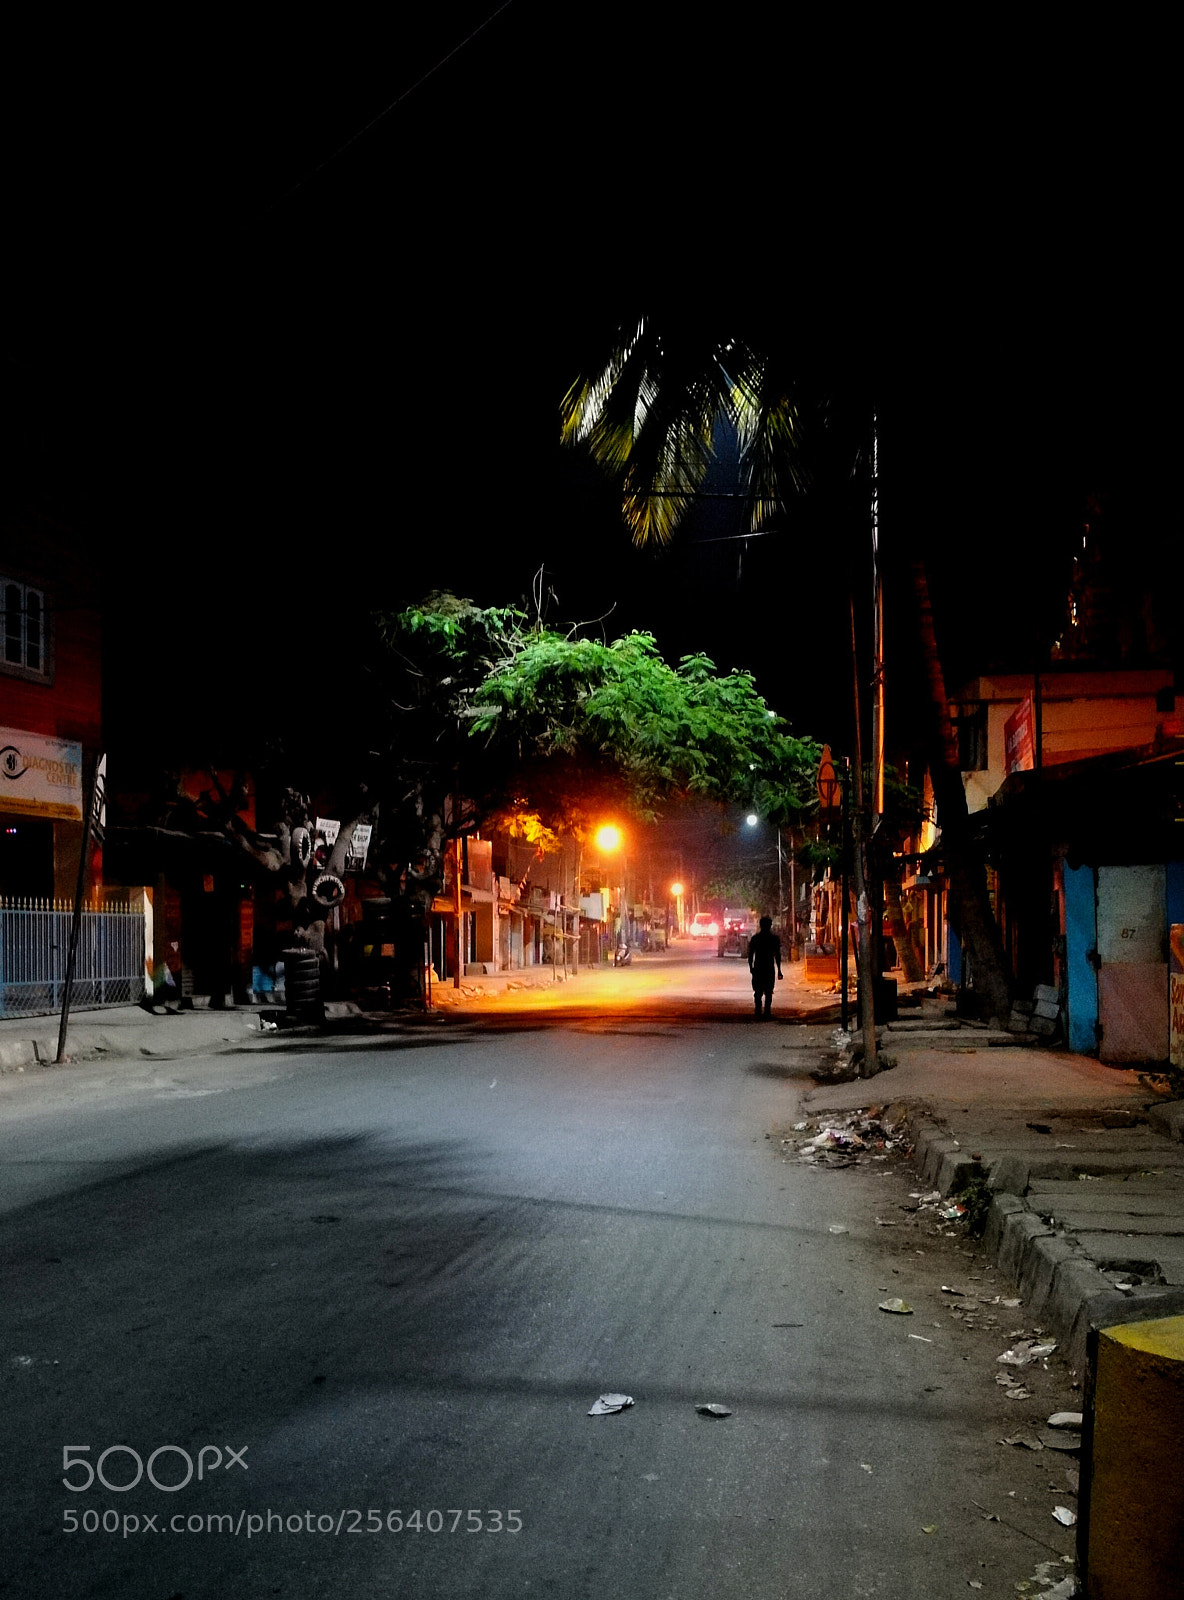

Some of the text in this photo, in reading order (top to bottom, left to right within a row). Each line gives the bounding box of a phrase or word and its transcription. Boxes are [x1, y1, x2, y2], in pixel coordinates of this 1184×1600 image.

[22, 755, 77, 774] DIAGNOSTIC
[46, 771, 77, 786] CENTRE
[1120, 928, 1136, 939] 87
